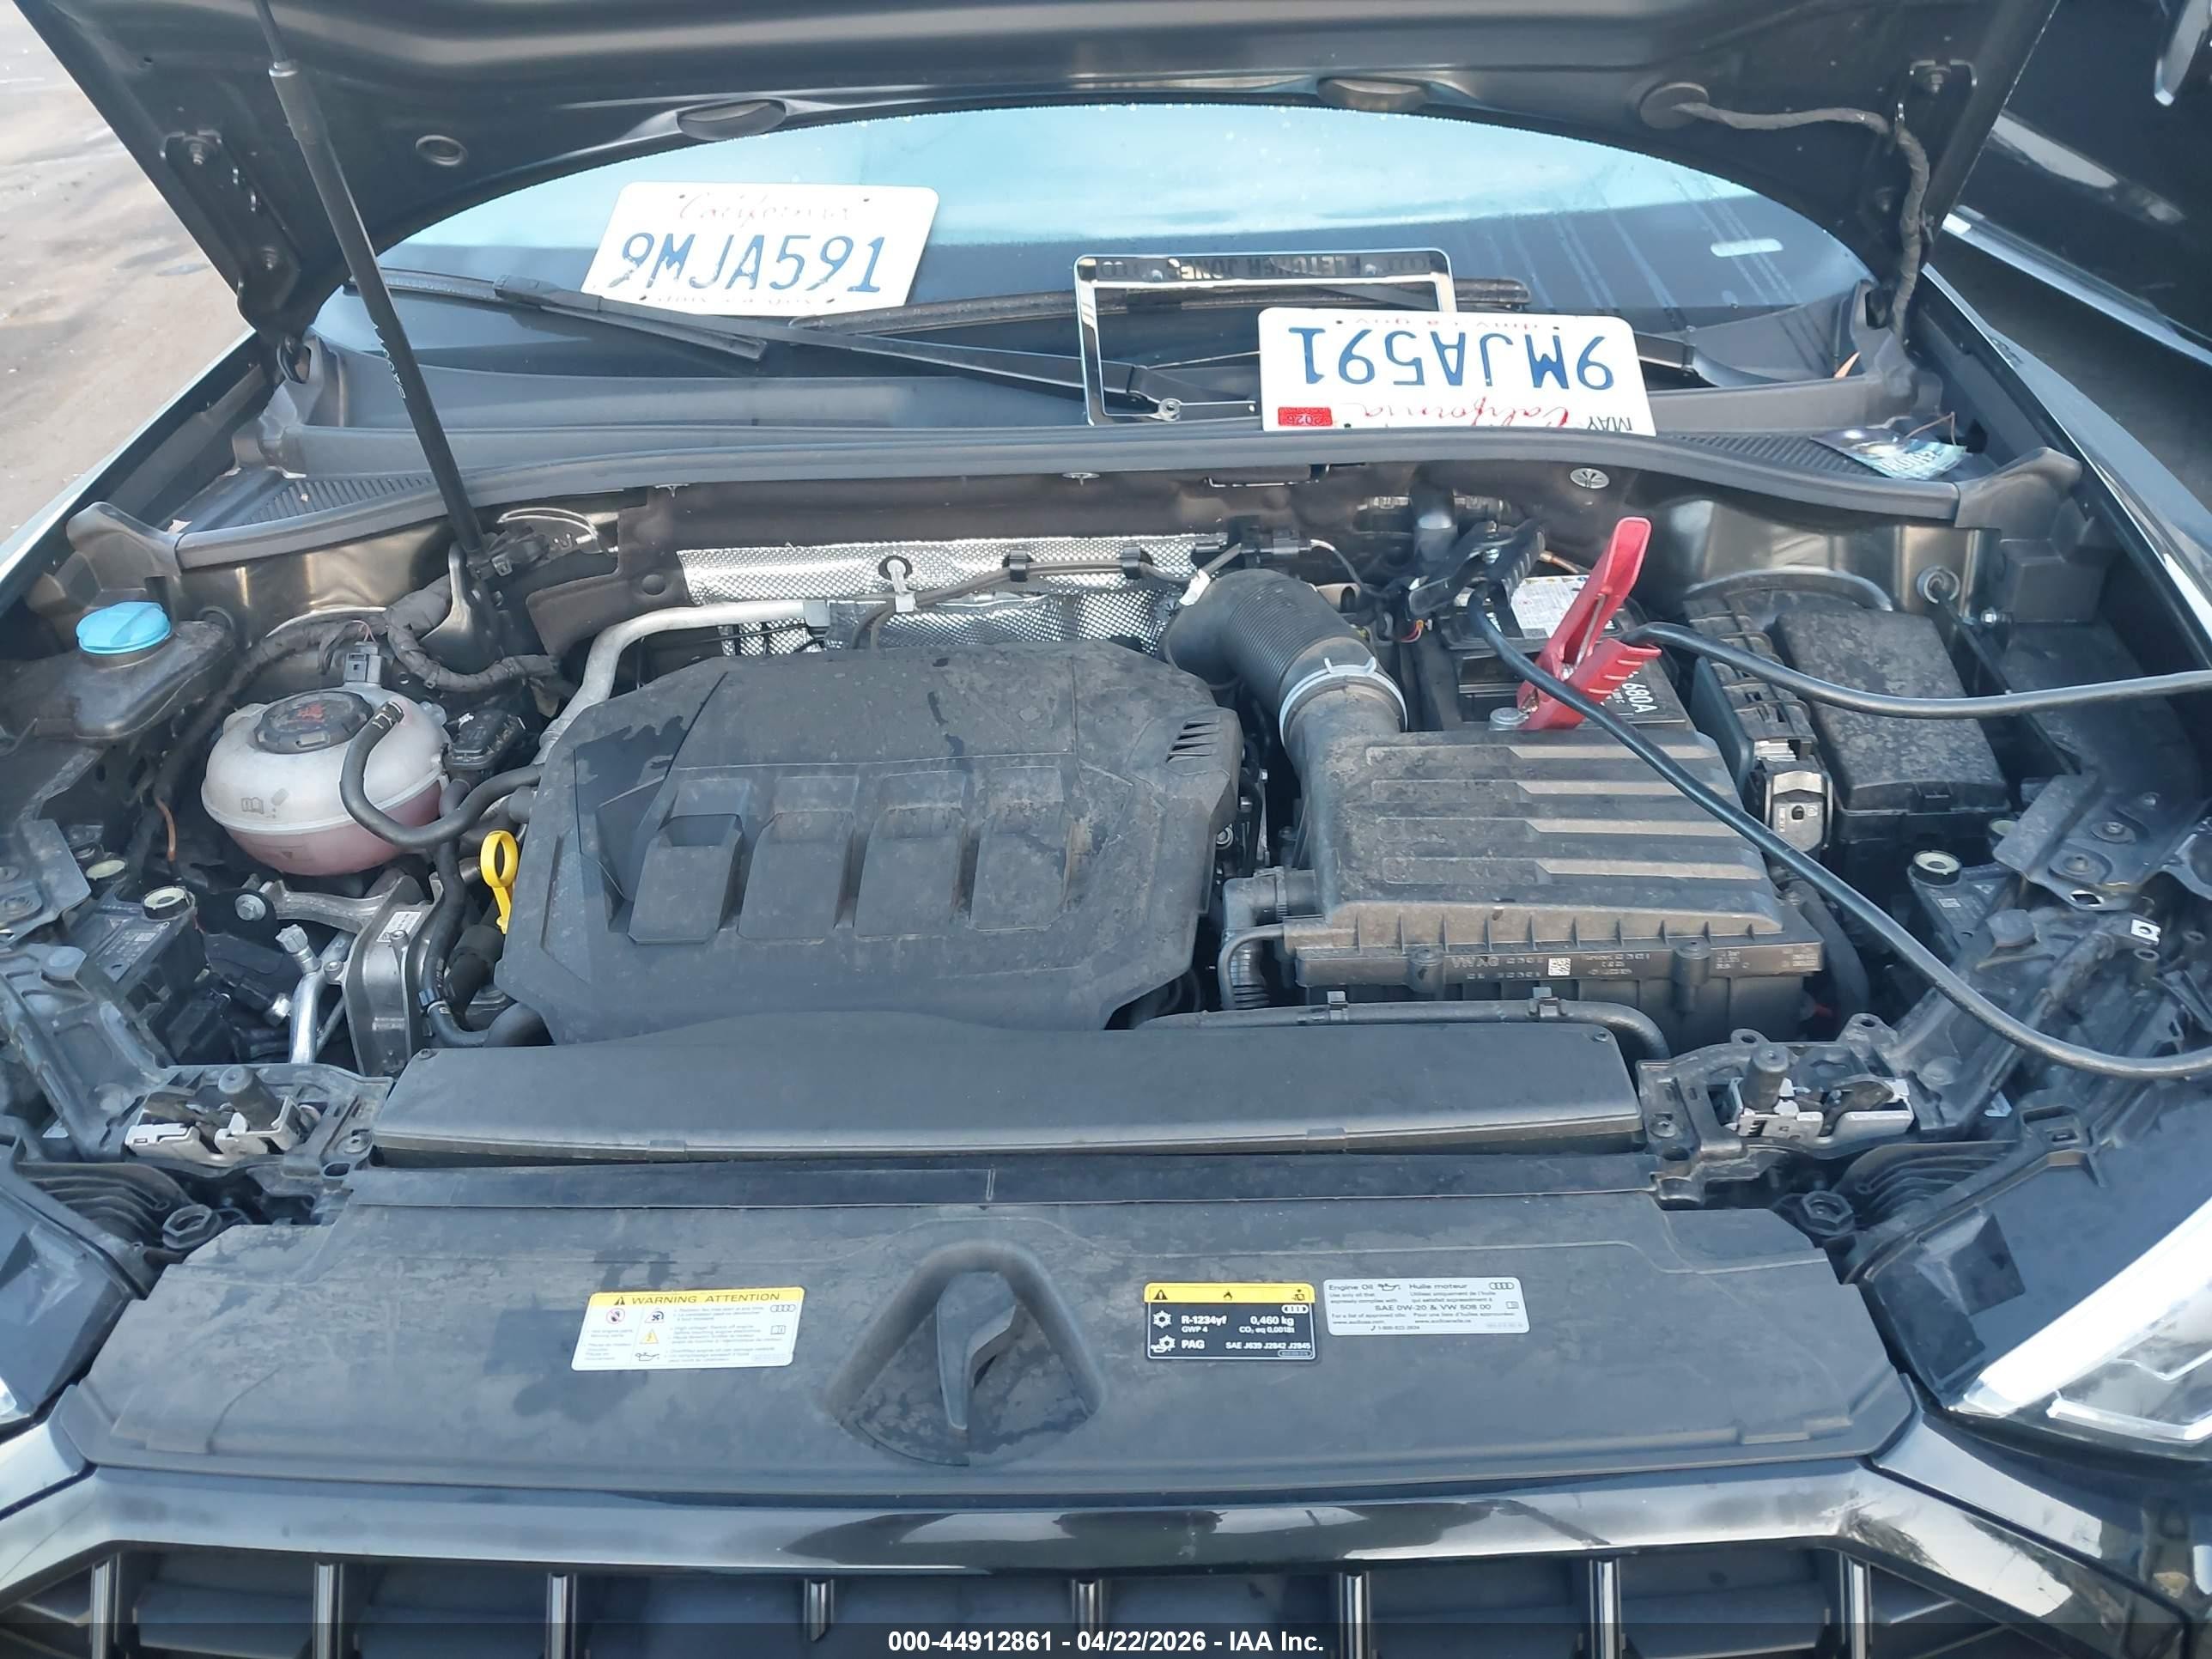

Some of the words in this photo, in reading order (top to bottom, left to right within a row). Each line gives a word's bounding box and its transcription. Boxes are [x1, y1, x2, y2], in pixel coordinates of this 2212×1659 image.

[607, 232, 886, 294] 9MJA591
[1288, 325, 1614, 391] 9MJA591
[1586, 415, 1633, 432] MAY
[1621, 682, 1658, 714] 680A
[631, 1295, 698, 1304] WARNING
[704, 1292, 781, 1304] ATTENTION
[1181, 1315, 1228, 1327] R-1234yf
[1280, 1316, 1295, 1327] kg
[1181, 1339, 1206, 1350] PAG
